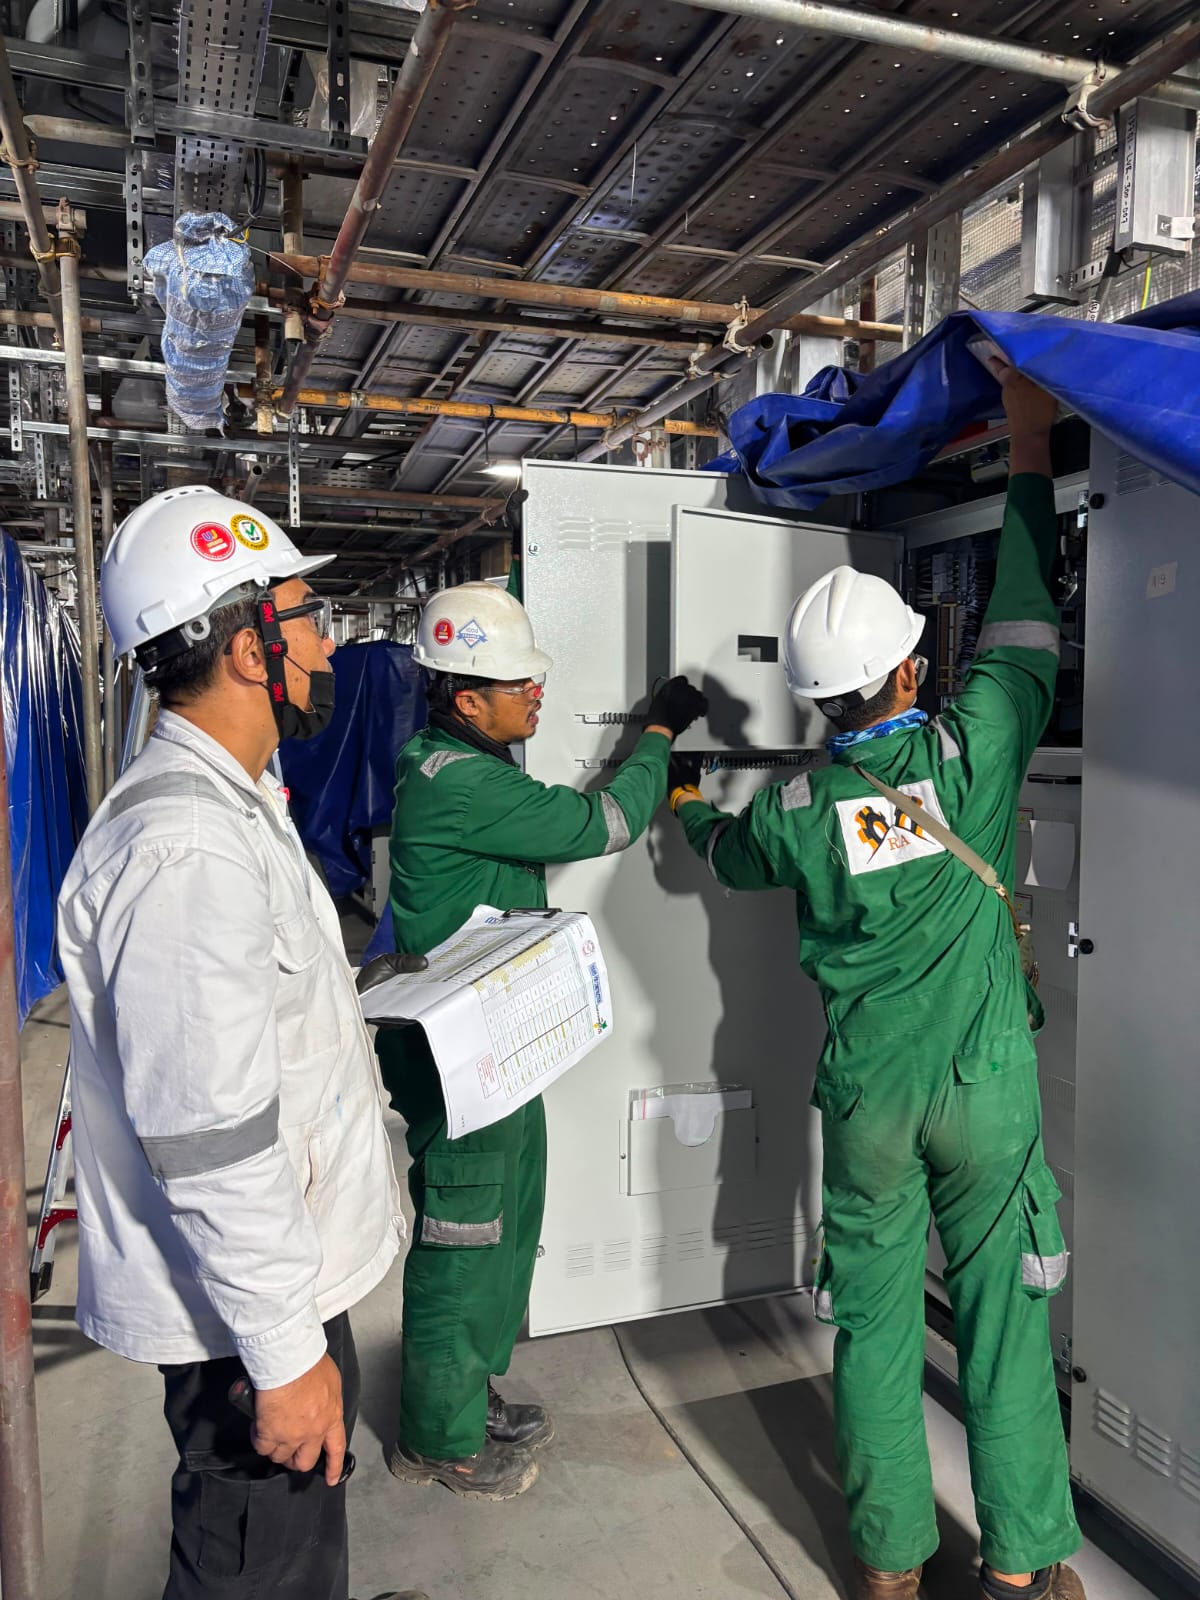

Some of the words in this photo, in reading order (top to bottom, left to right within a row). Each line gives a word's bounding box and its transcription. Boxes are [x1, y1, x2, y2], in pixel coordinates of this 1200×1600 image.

[262, 602, 275, 623] 3M
[272, 682, 284, 703] 3M
[887, 834, 910, 850] RA
